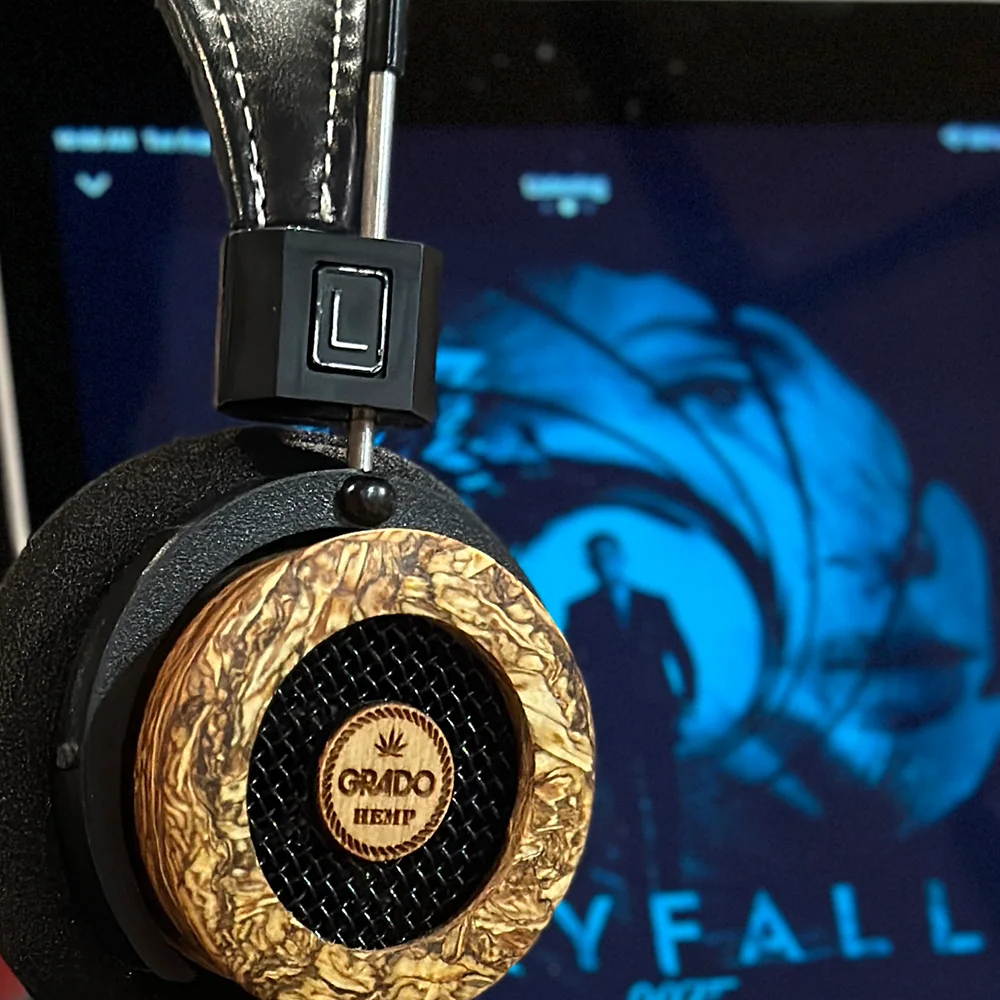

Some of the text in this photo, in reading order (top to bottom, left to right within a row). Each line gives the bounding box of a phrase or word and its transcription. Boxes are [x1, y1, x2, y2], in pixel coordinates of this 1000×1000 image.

[331, 290, 369, 352] L
[338, 768, 436, 799] GRADO
[353, 808, 417, 826] HEMP
[506, 877, 986, 977] YFALL
